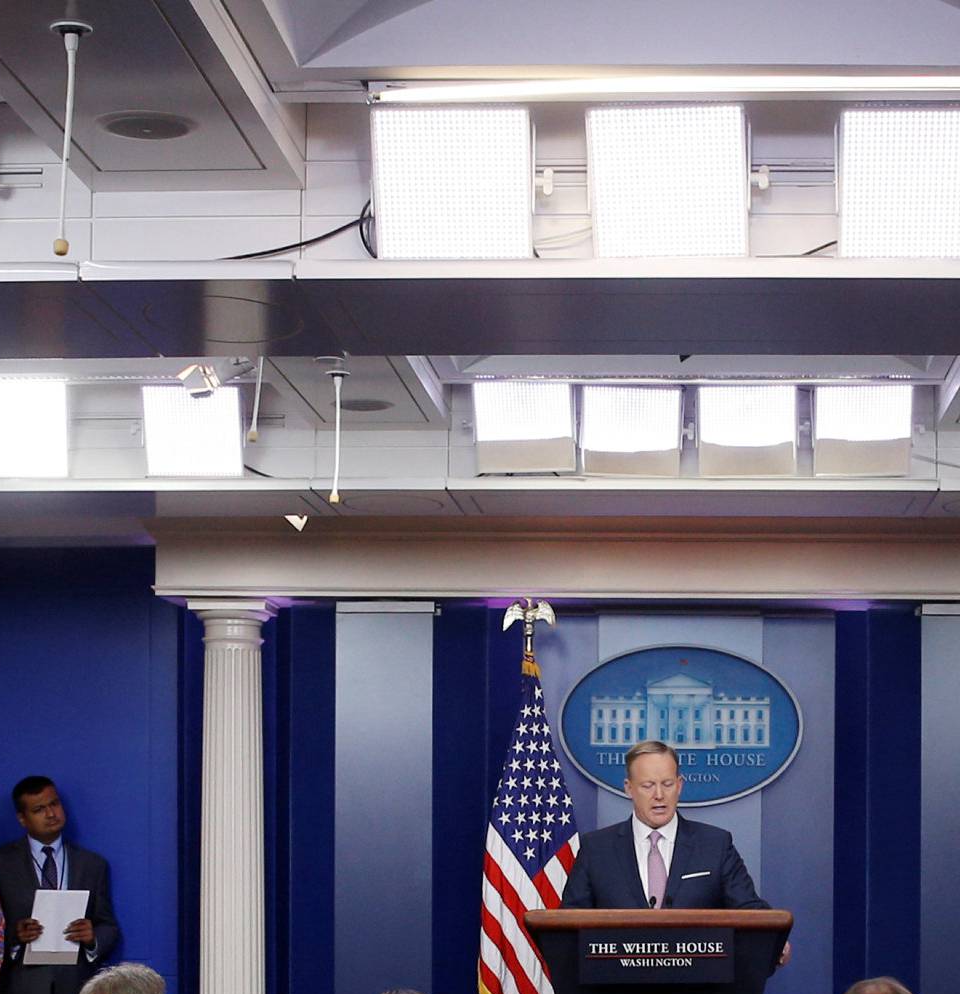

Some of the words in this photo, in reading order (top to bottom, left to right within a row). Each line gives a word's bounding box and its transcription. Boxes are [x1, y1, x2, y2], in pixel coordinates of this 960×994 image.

[707, 753, 766, 766] HOUSE
[680, 773, 720, 782] NGTON
[589, 943, 618, 954] THE
[622, 943, 669, 954] WHITE
[676, 942, 724, 953] HOUSE
[620, 958, 692, 967] WASHINGTON
